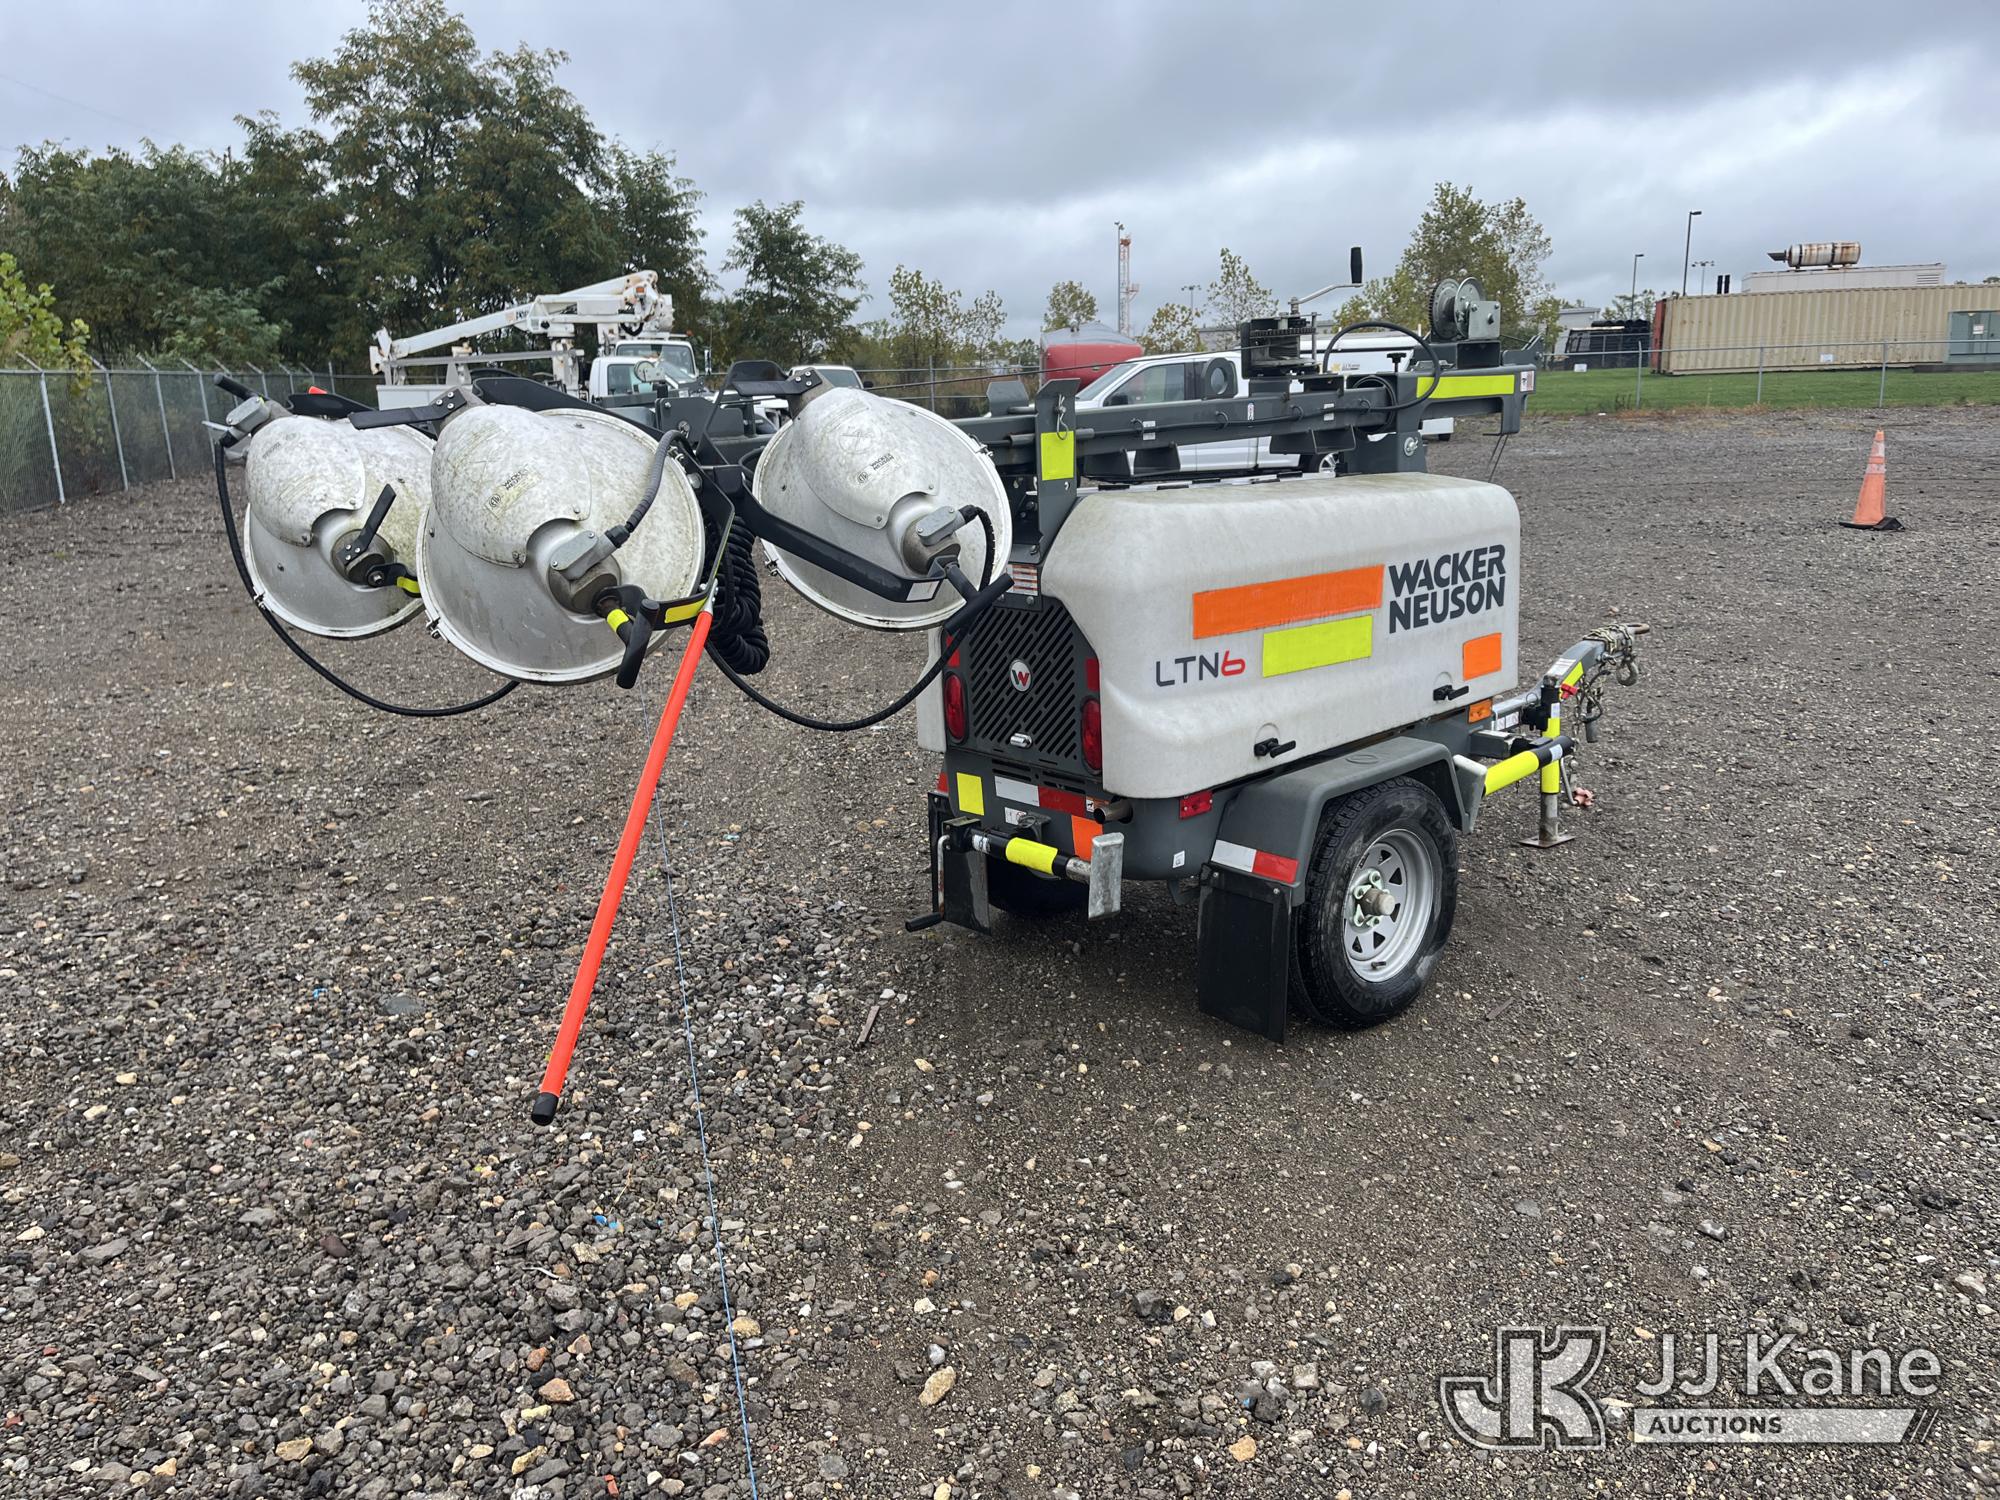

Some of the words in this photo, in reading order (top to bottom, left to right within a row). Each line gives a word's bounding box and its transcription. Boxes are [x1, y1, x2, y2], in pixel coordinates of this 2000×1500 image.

[1388, 544, 1507, 598] WACKER
[1389, 576, 1506, 634] NEUSON
[1156, 650, 1246, 687] LTN6
